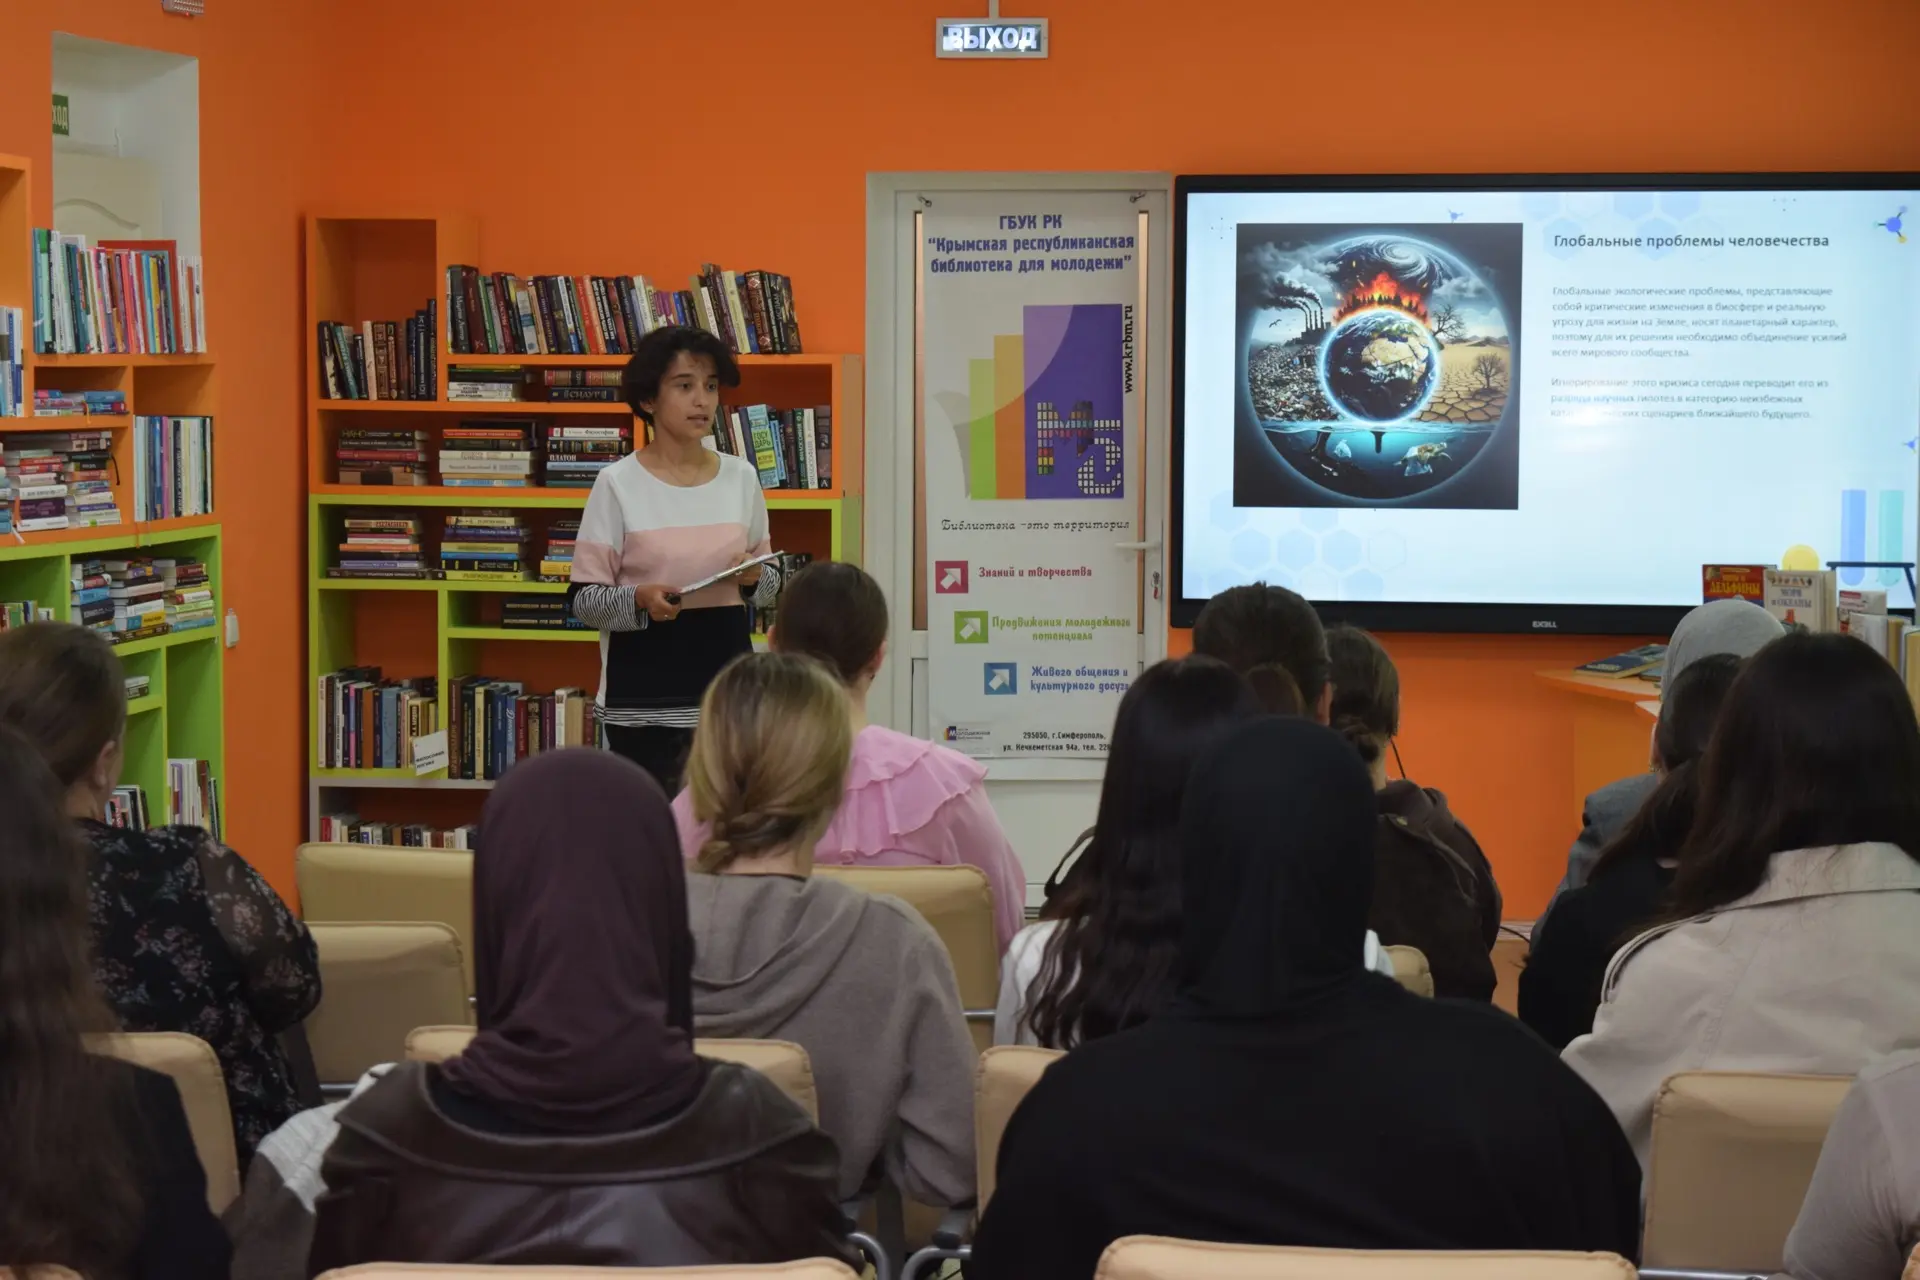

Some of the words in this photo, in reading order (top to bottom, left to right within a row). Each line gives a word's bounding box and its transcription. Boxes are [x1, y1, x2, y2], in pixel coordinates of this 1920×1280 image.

[946, 27, 1038, 50] ВЫХОД
[999, 214, 1037, 230] ГБУК
[1042, 213, 1063, 229] РК
[1012, 235, 1135, 253] республиканская
[1554, 234, 1642, 247] Глобальные
[1646, 235, 1725, 250] проблемы
[1728, 236, 1830, 248] человечества
[930, 258, 1013, 273] библиотека
[1017, 258, 1045, 273] для
[1552, 286, 1612, 296] Глобальные
[1614, 287, 1686, 297] экологические
[1746, 287, 1834, 298] представляющие
[1552, 302, 1582, 311] собой
[1584, 303, 1647, 313] критические
[1649, 303, 1705, 312] изменения
[1715, 302, 1765, 313] биосфере
[1775, 303, 1827, 313] реальную
[1552, 318, 1584, 328] угрозу
[1585, 318, 1604, 328] для
[1606, 318, 1639, 326] жизни
[1641, 318, 1653, 326] на
[1691, 318, 1719, 327] носят
[1721, 317, 1789, 328] планетарный
[1552, 333, 1592, 343] поэтому
[1594, 333, 1613, 342] для
[1615, 333, 1627, 341] их
[1629, 333, 1674, 343] решения
[1676, 332, 1738, 343] необходимо
[1740, 332, 1809, 343] объединение
[1811, 332, 1848, 343] усилий
[1122, 304, 1134, 394] www.krbm.ru
[1551, 348, 1579, 358] всего
[1580, 348, 1629, 358] мирового
[1631, 378, 1657, 388] этого
[1659, 378, 1700, 389] кризиса
[1701, 379, 1741, 390] сегодня
[1742, 379, 1796, 390] переводит
[1798, 379, 1815, 388] его
[1816, 379, 1829, 388] из
[1637, 395, 1675, 405] гипотез
[1677, 395, 1683, 403] в
[1685, 395, 1738, 405] категорию
[1740, 394, 1803, 404] неизбежных
[1641, 410, 1695, 420] сценариев
[1696, 409, 1760, 419] ближайшего
[941, 518, 1016, 531] Библиотека
[1053, 519, 1130, 533] территория
[978, 565, 1015, 578] Знаний
[1018, 569, 1025, 578] и
[1028, 566, 1092, 580] творчества
[992, 615, 1062, 630] Продвижения
[1065, 615, 1131, 630] молодежного
[1032, 631, 1093, 642] потенциала
[1031, 666, 1072, 678] Живого
[1075, 666, 1120, 679] общения
[1123, 668, 1129, 677] и
[1030, 680, 1095, 693] культурного
[1022, 731, 1050, 740] 295050,
